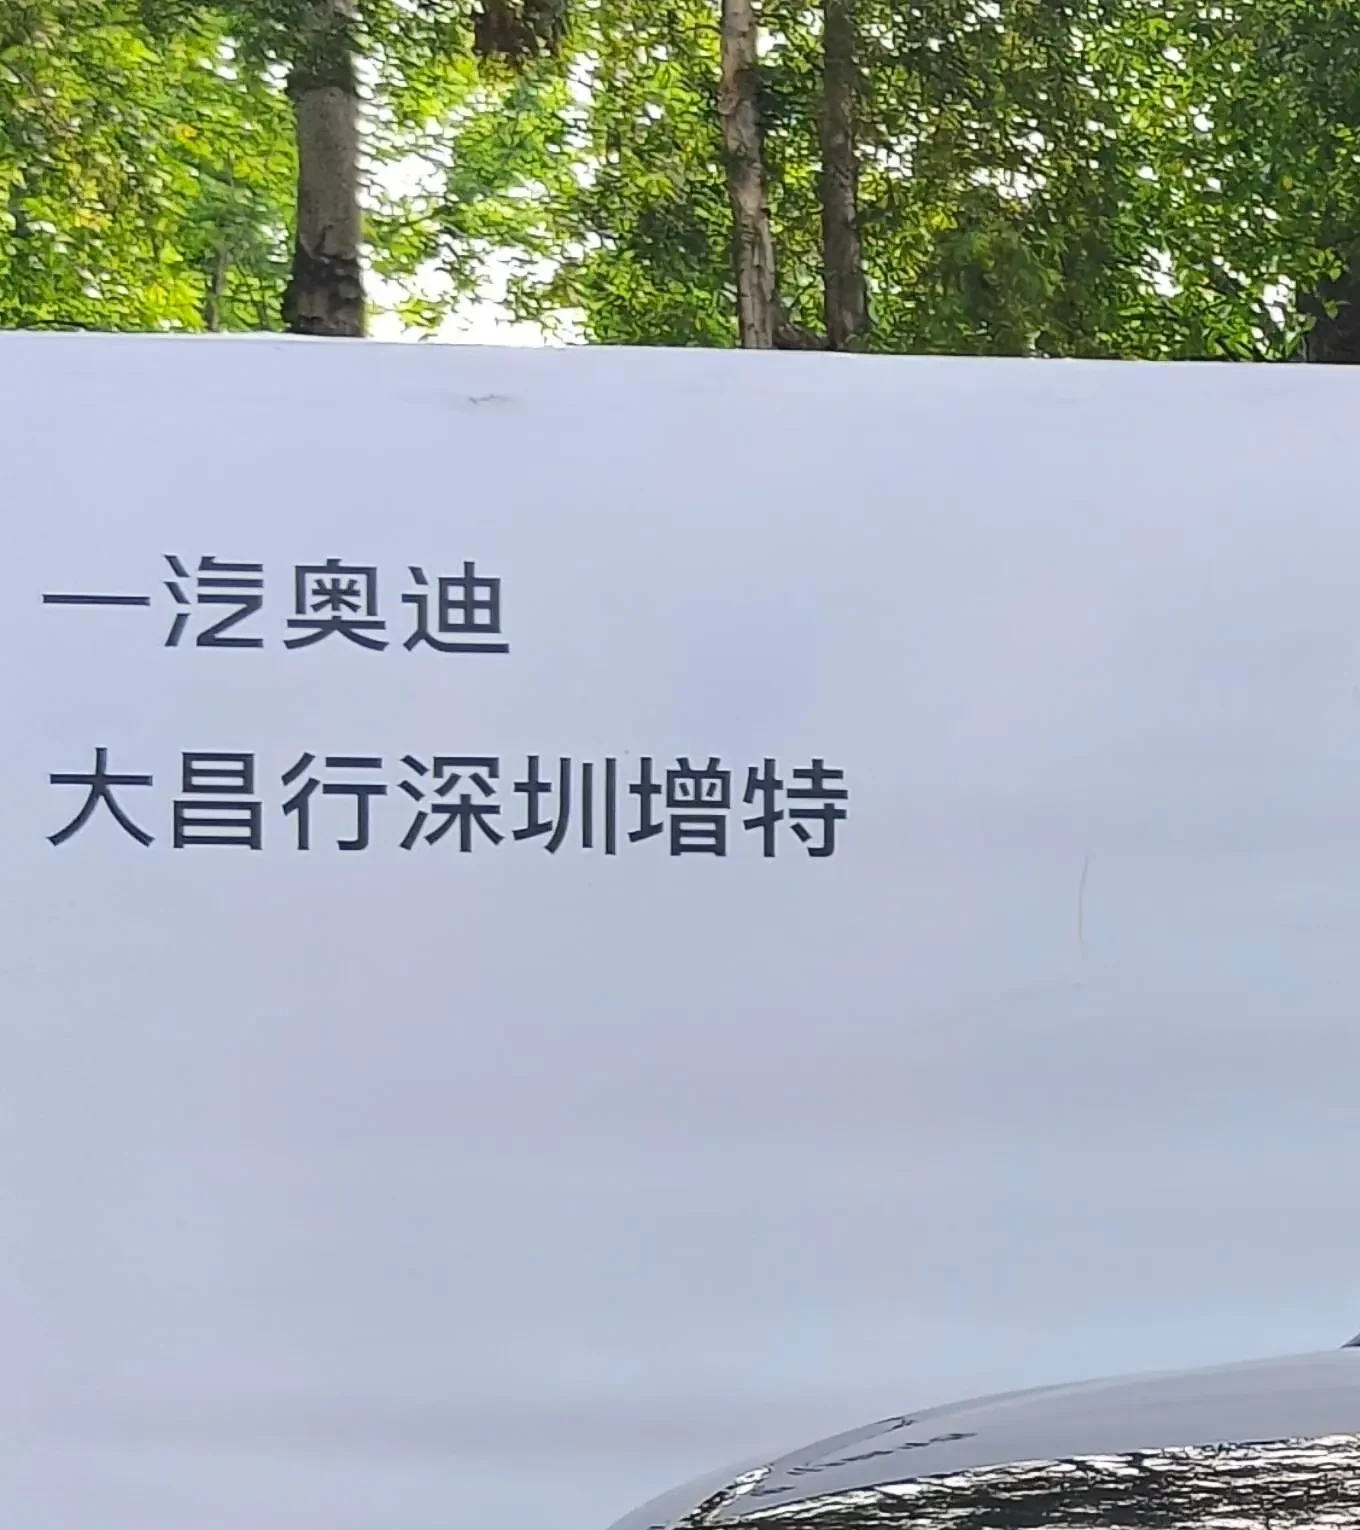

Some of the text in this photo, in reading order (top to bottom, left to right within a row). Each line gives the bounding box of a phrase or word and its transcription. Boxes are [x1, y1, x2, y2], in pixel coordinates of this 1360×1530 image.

[43, 553, 510, 654] 一汽奥迪
[46, 746, 850, 858] 大昌行深圳增特
